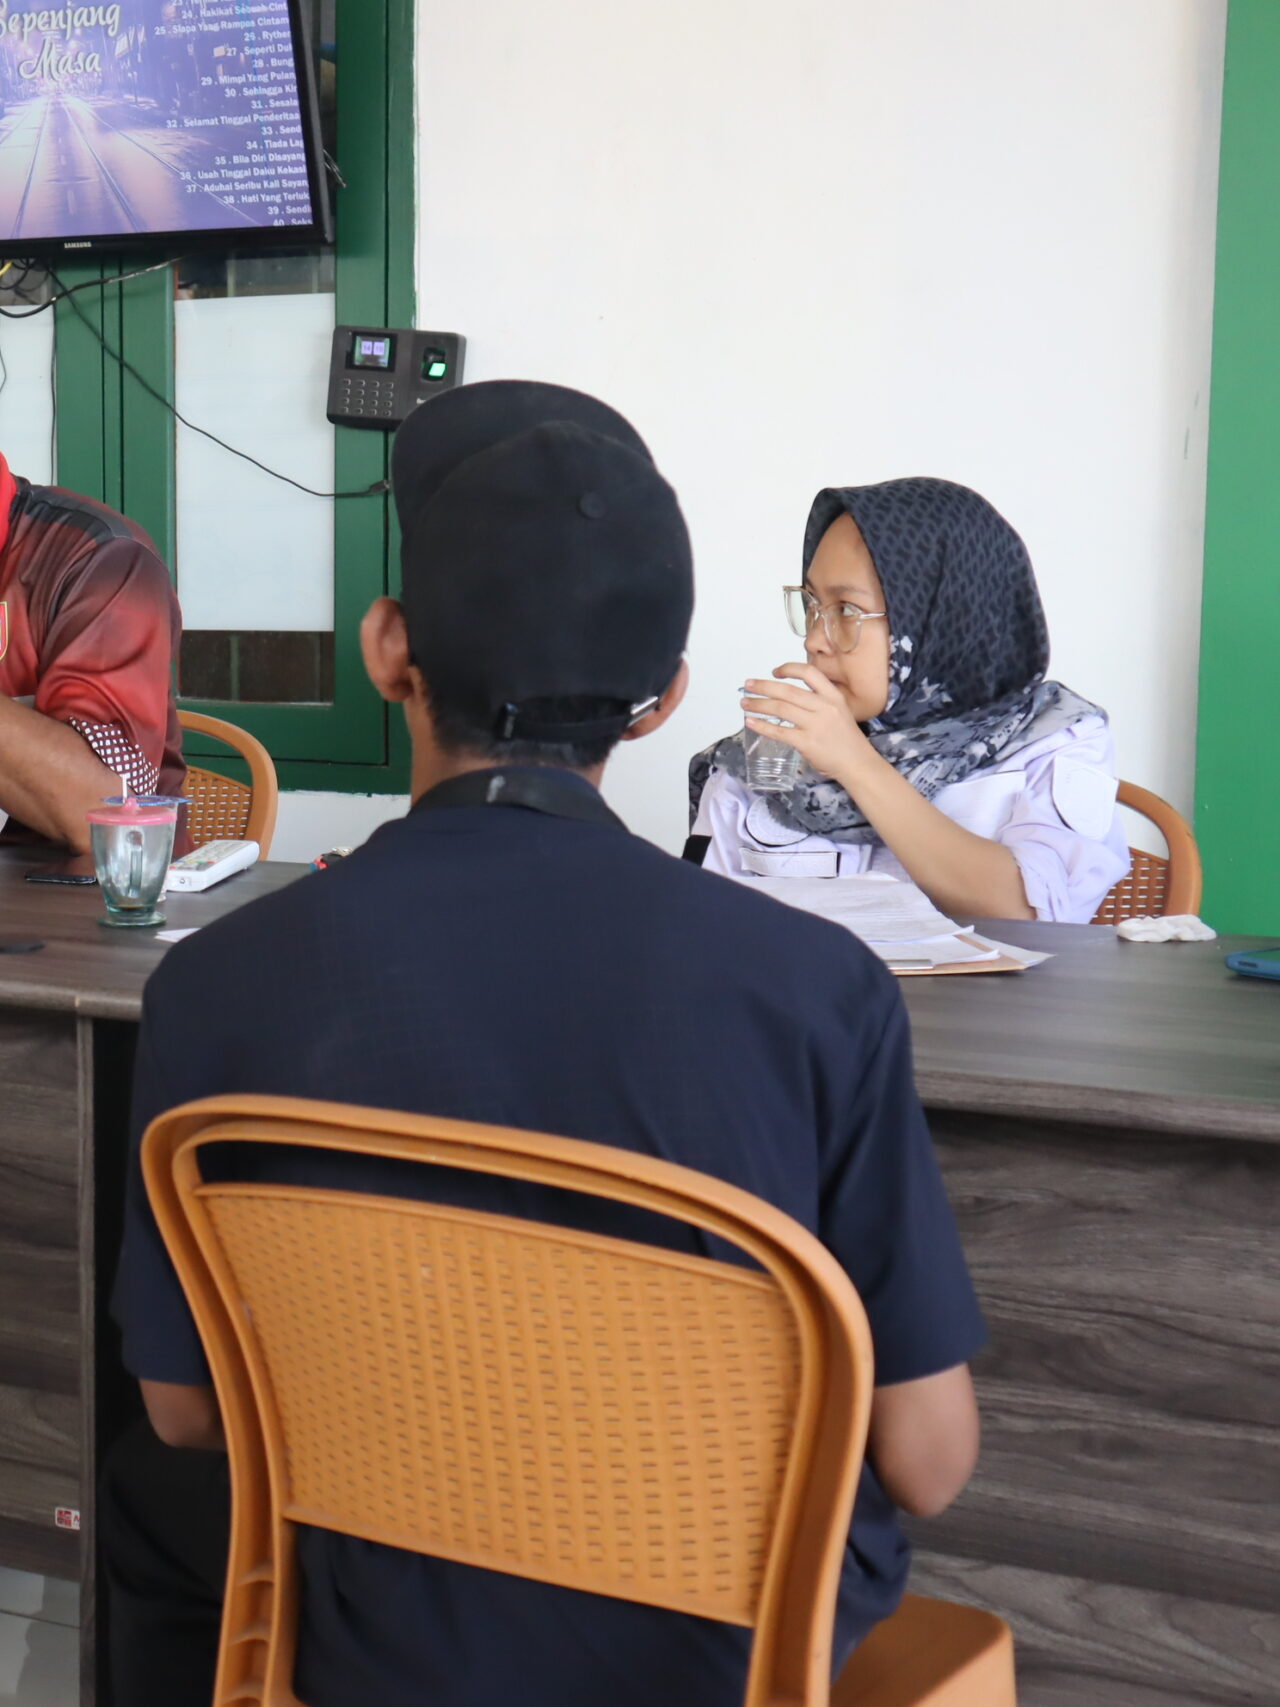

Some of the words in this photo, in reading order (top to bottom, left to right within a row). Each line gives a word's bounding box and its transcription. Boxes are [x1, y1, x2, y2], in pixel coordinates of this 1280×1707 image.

[19, 36, 102, 82] Masa
[270, 72, 295, 80] Pulan
[281, 178, 308, 188] Sayan
